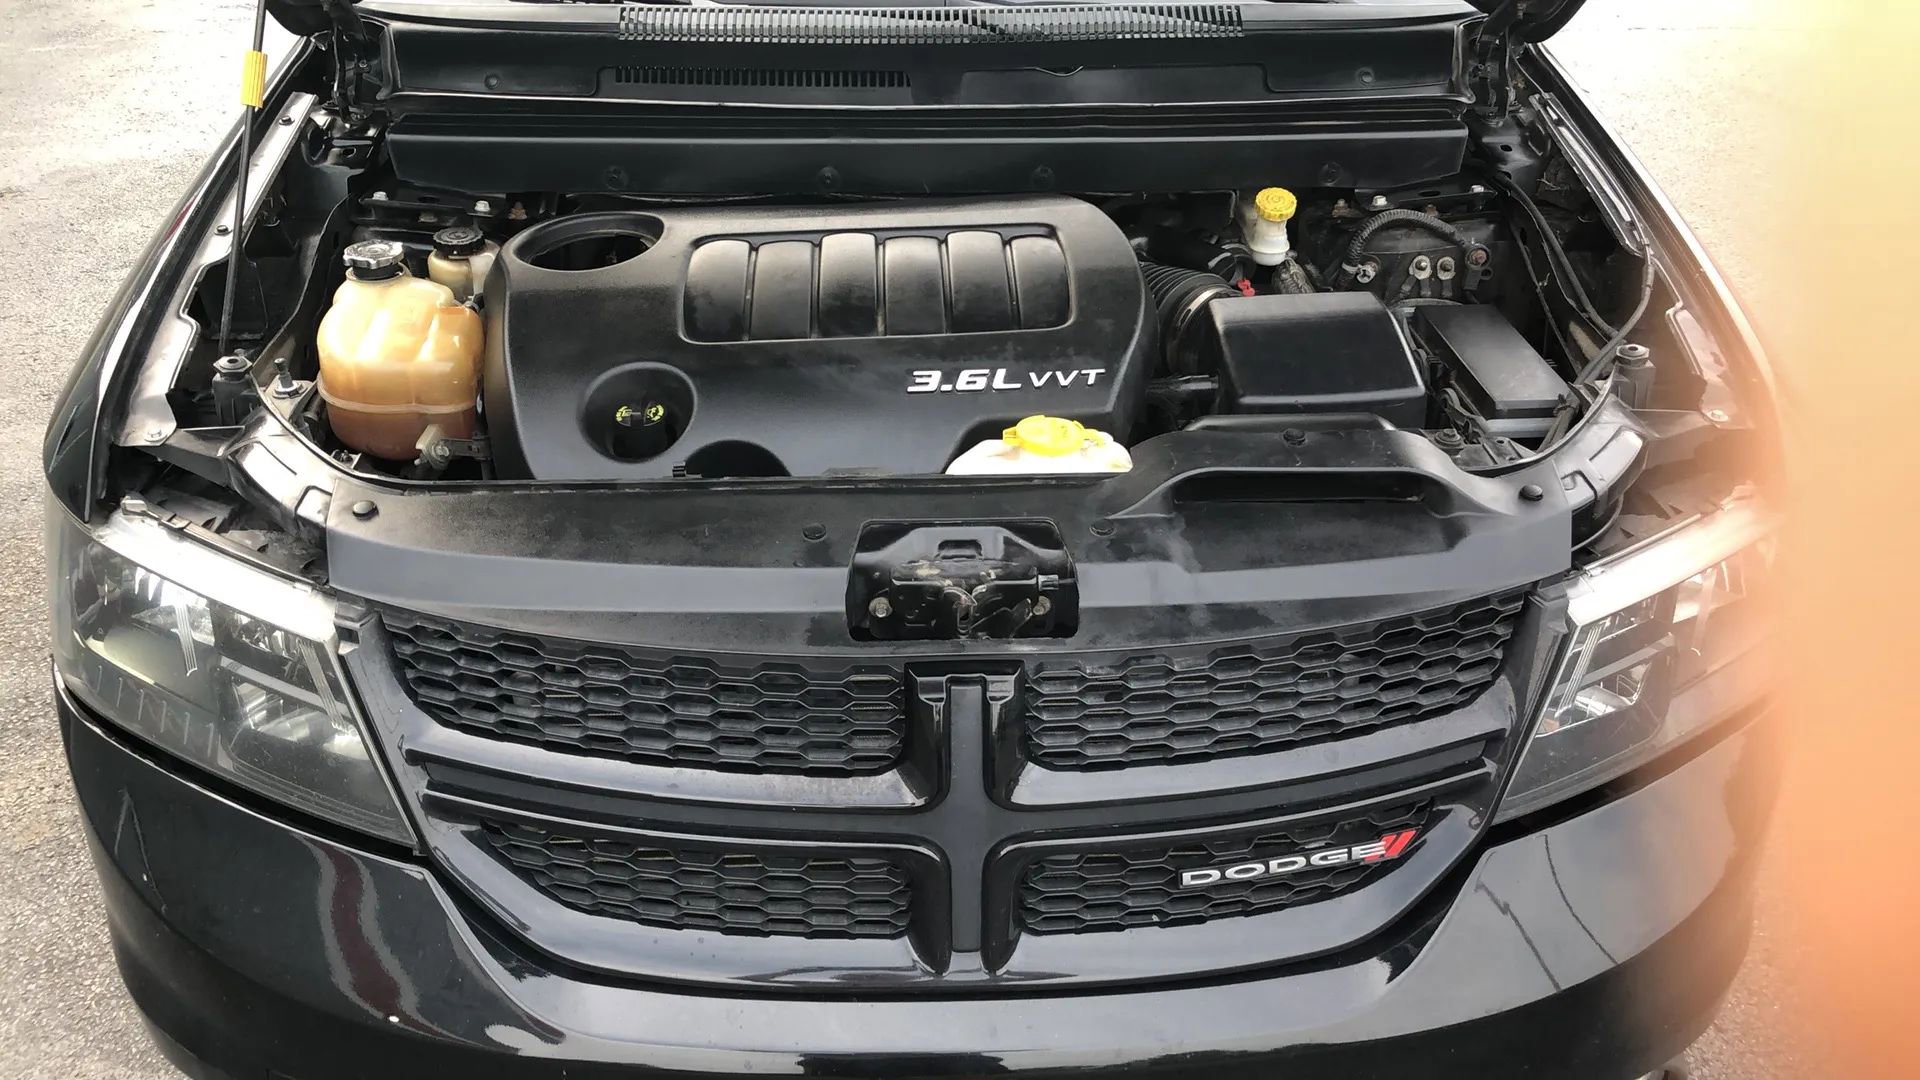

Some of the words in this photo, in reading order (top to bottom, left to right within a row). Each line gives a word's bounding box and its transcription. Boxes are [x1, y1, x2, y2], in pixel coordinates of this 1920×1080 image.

[907, 368, 1022, 393] 3.6L
[1028, 368, 1106, 388] VVT
[1182, 841, 1386, 886] DODGE
